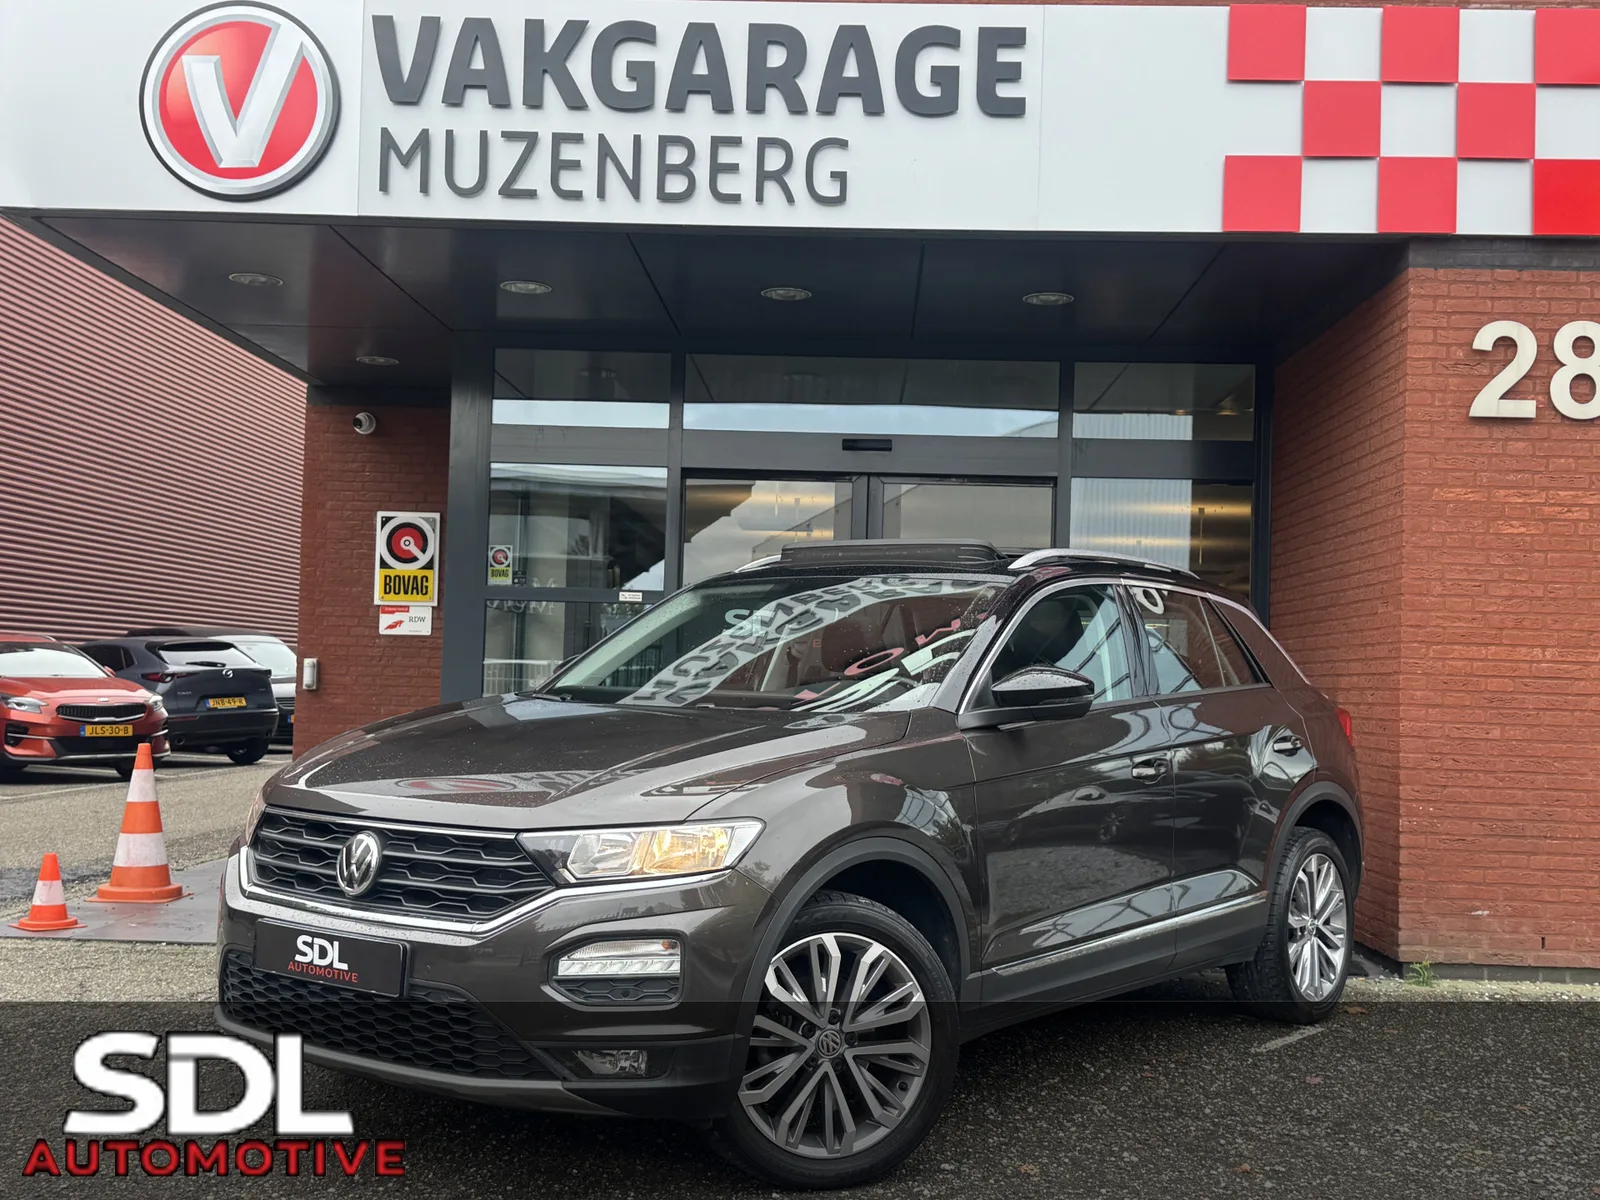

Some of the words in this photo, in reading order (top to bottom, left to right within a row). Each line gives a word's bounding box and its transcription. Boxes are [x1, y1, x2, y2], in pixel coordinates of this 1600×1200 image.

[371, 14, 1028, 118] VAKGARAGE
[378, 126, 849, 206] MUZENBERG
[1468, 319, 1600, 420] 28
[383, 573, 430, 597] BOVAG
[490, 567, 510, 579] BOVAG
[408, 615, 427, 624] RDW
[88, 725, 130, 736] JLS-30-B
[294, 934, 349, 971] SDL
[287, 960, 359, 983] AUTOMOTIVE
